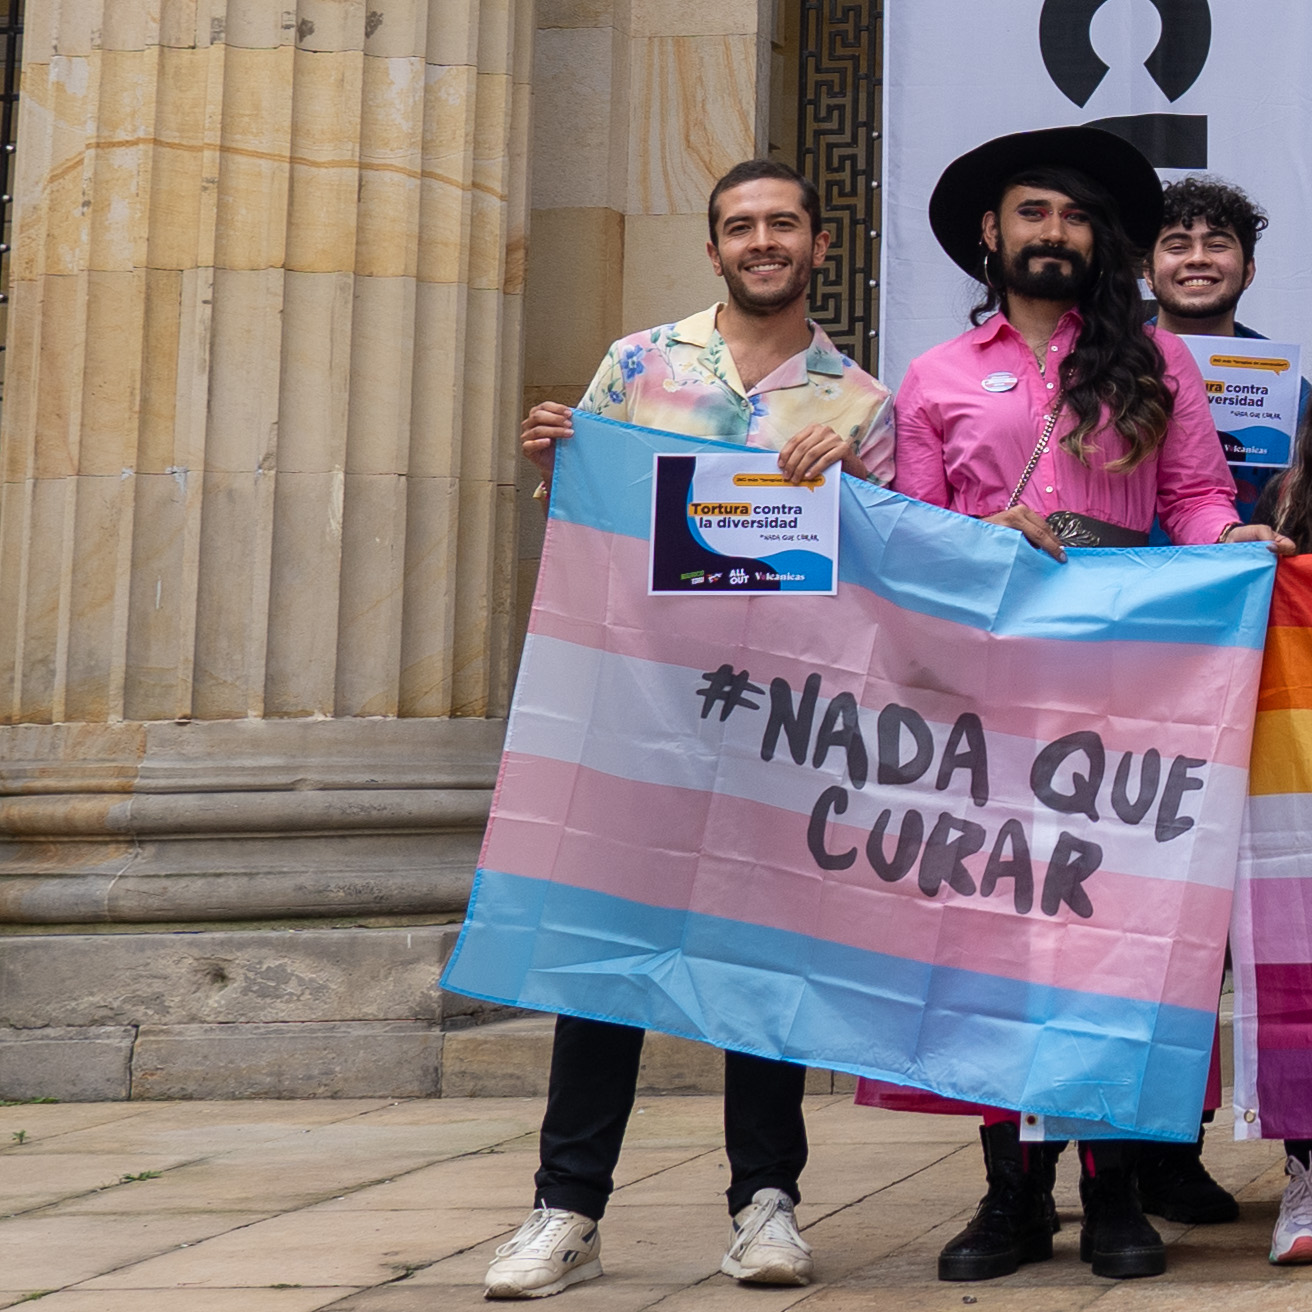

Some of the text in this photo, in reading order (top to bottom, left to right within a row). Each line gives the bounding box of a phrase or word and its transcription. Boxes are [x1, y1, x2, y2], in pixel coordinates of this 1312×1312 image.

[1225, 384, 1269, 395] contra
[1208, 395, 1264, 407] versidad
[691, 503, 803, 515] Tortura contra
[699, 516, 798, 529] la diversidad
[729, 568, 745, 577] ALL
[729, 575, 749, 585] OUT
[696, 663, 1207, 842] #NADA QUE
[807, 785, 1104, 919] CURAR
